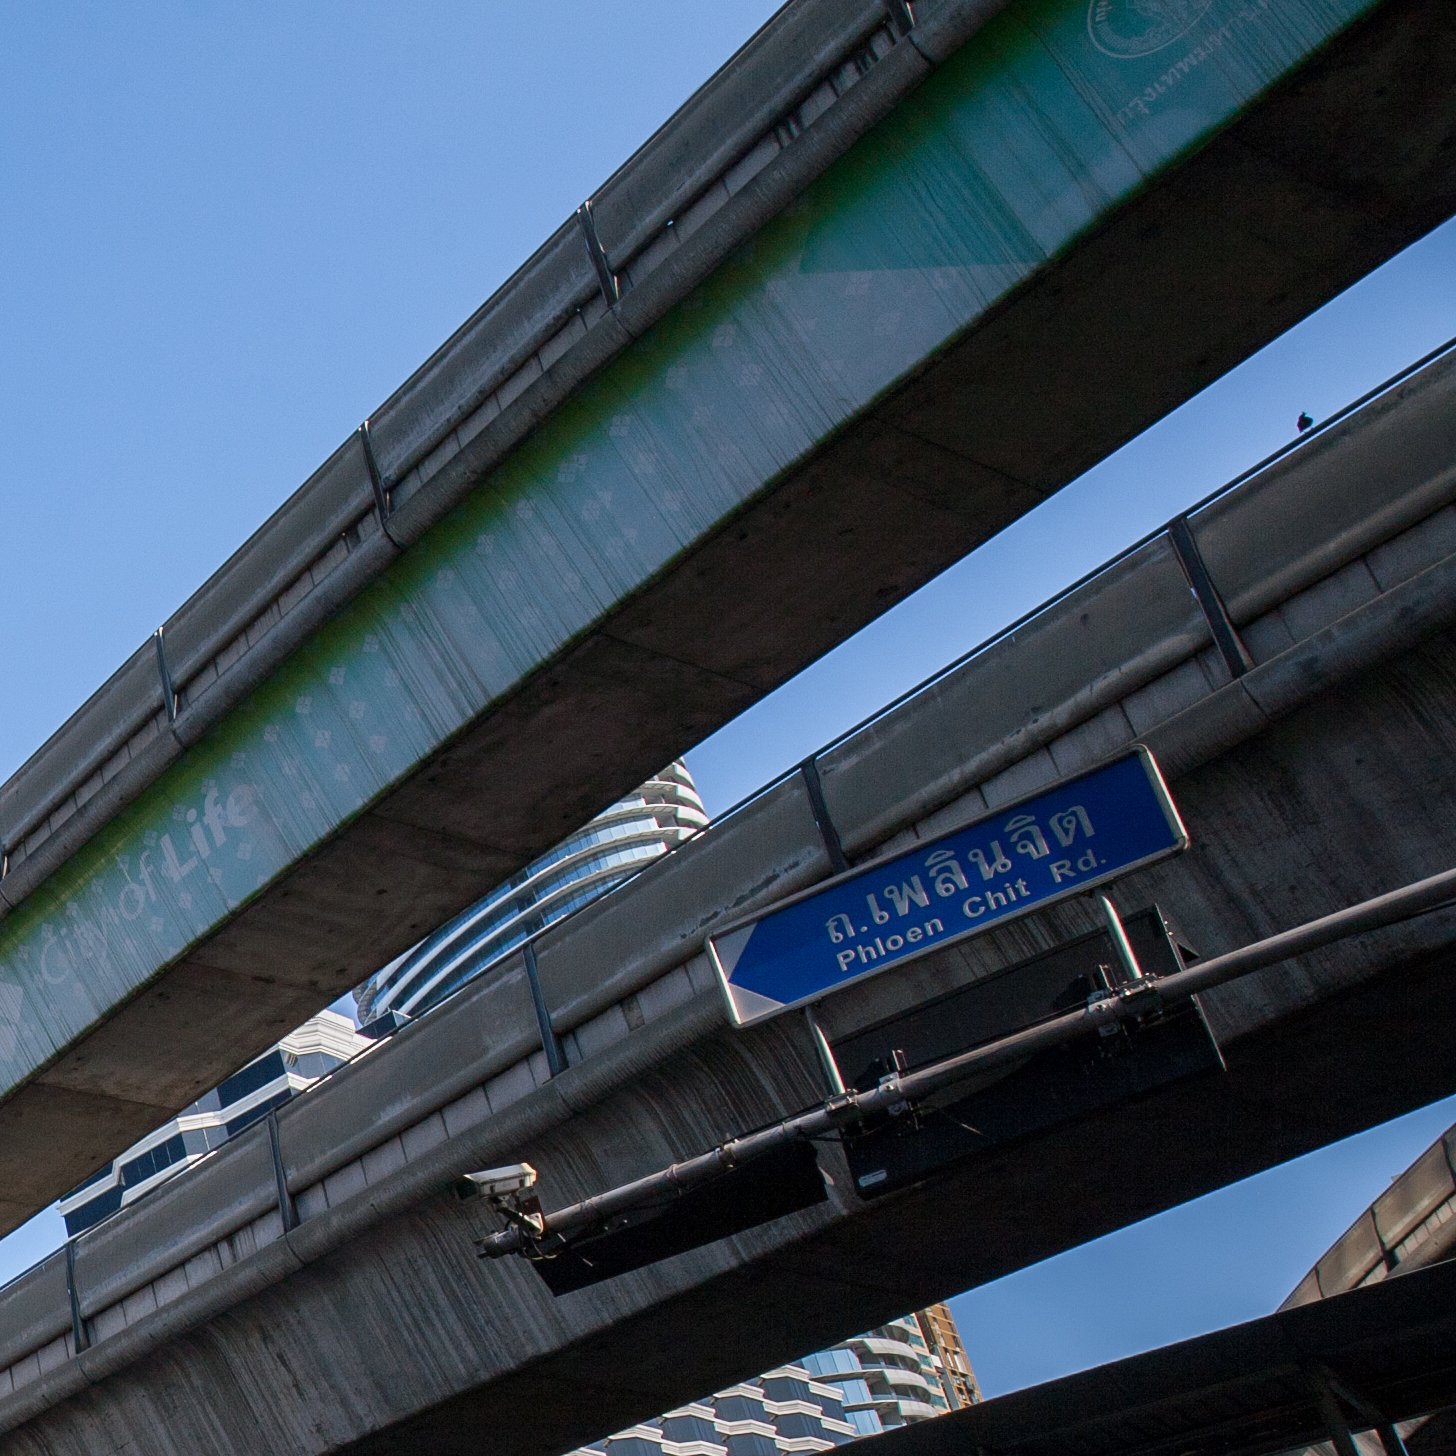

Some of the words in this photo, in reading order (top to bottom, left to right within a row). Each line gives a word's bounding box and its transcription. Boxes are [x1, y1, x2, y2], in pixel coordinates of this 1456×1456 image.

[159, 780, 266, 880] Life
[836, 917, 944, 972] Phloen
[962, 877, 1031, 919] Chit
[1049, 848, 1106, 883] Rd.
